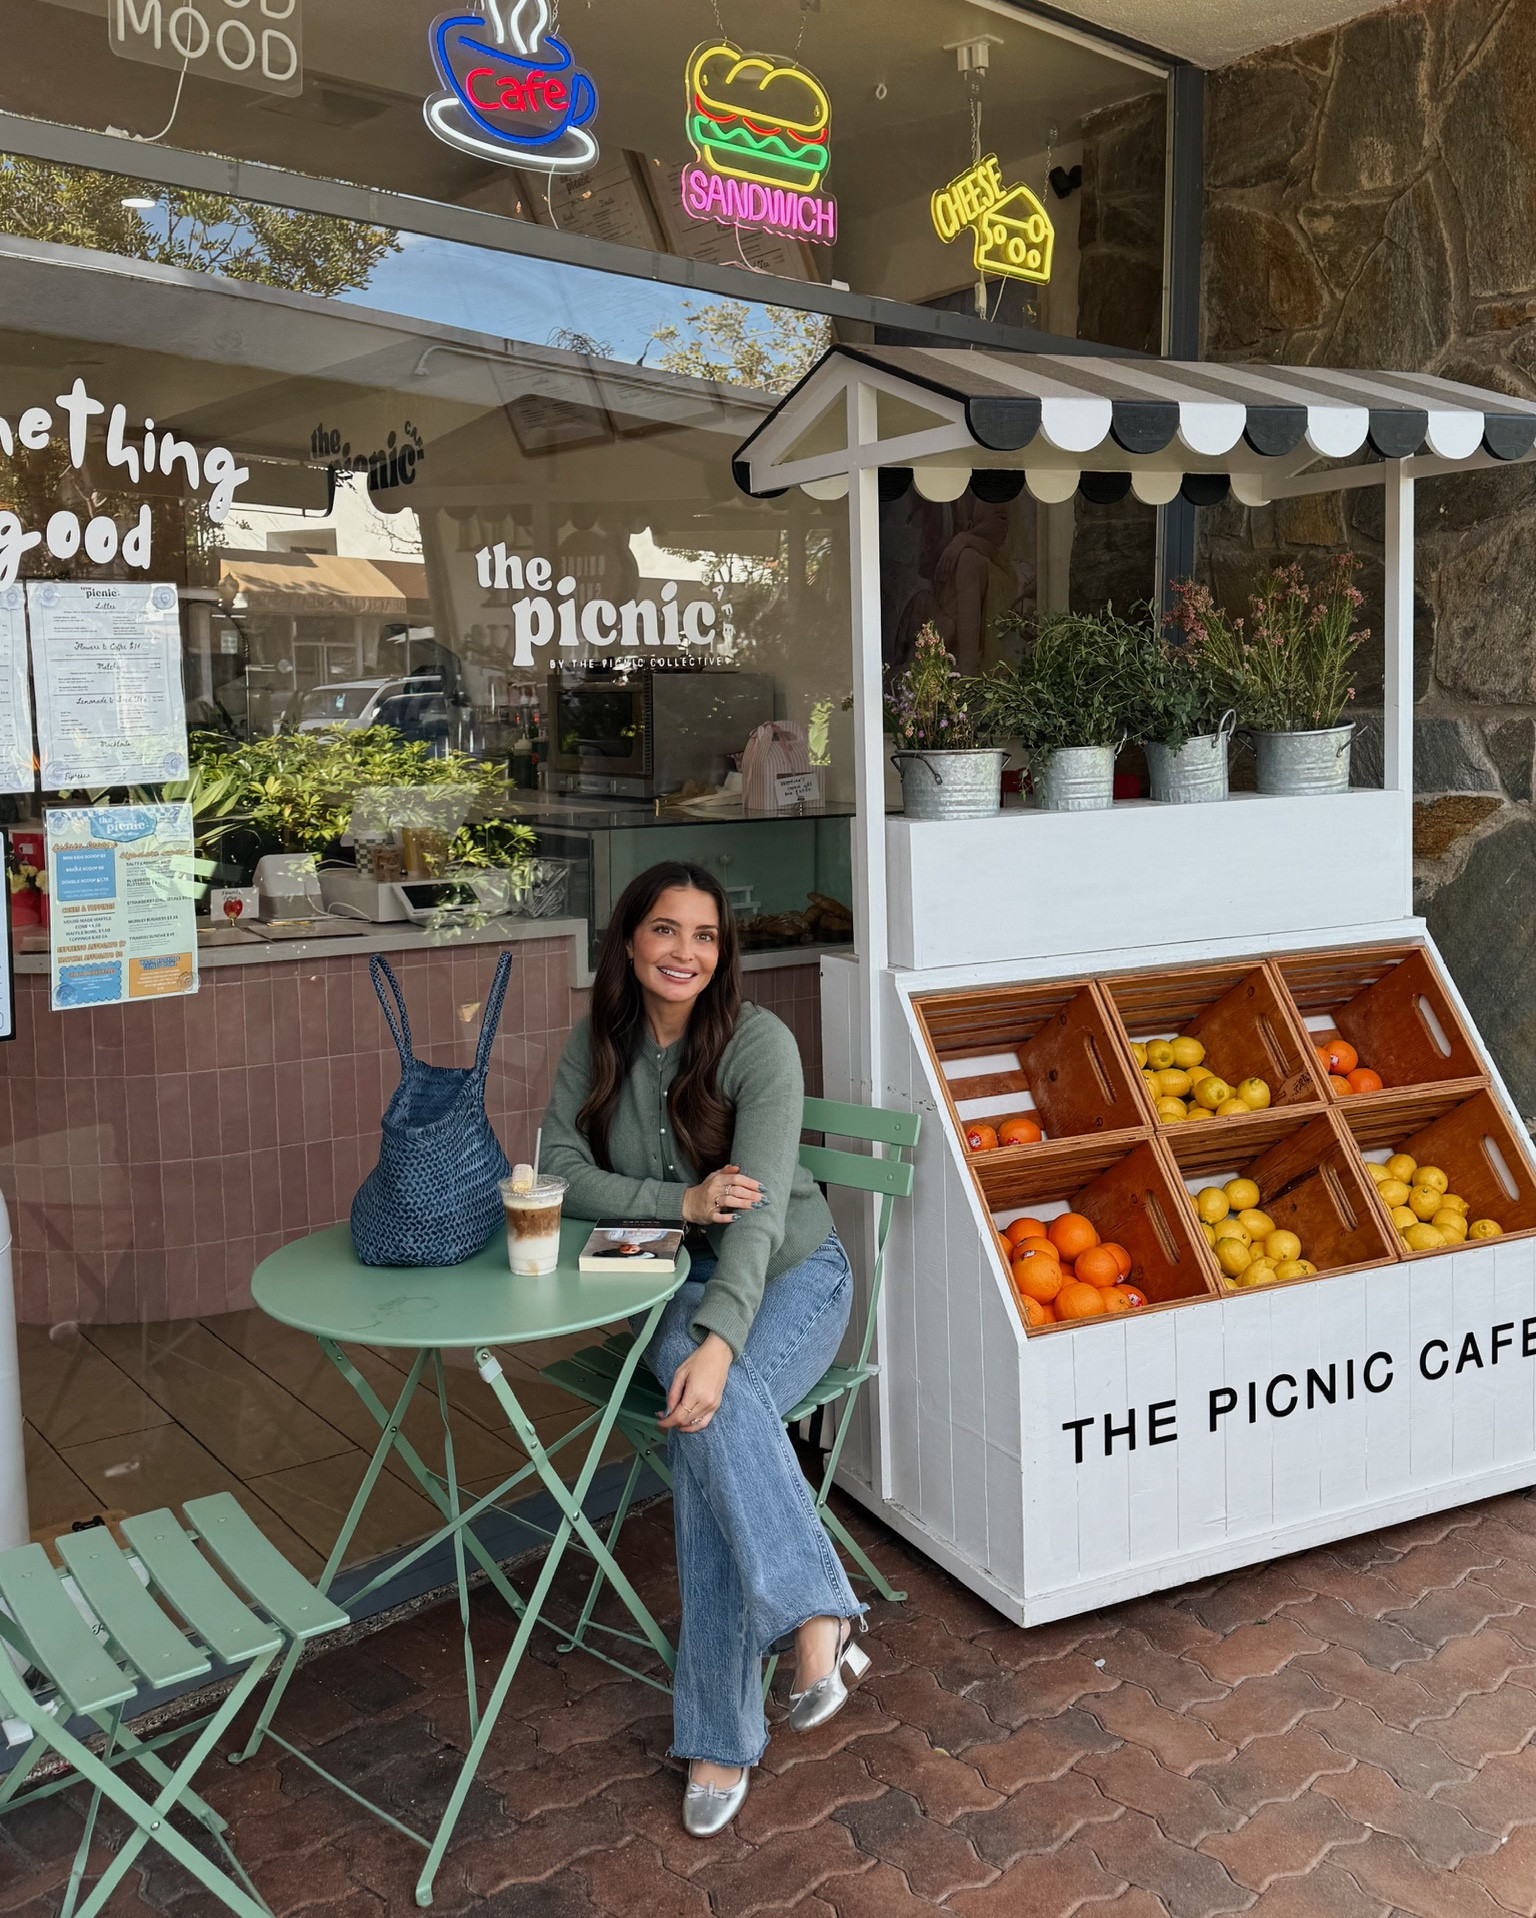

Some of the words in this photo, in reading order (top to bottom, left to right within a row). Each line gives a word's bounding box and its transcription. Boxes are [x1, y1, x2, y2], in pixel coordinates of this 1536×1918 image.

[117, 0, 297, 80] MOOD
[465, 67, 570, 112] Cafe
[689, 169, 835, 238] SANDWICH
[936, 157, 1007, 238] CHEESE
[475, 542, 552, 591] the
[512, 581, 716, 667] picnic
[550, 659, 564, 669] BY
[572, 658, 594, 669] THE
[650, 656, 722, 668] COLLECTIVE
[1062, 1399, 1178, 1464] THE
[1209, 1351, 1395, 1432] PICNIC
[1419, 1317, 1536, 1380] CAFE
